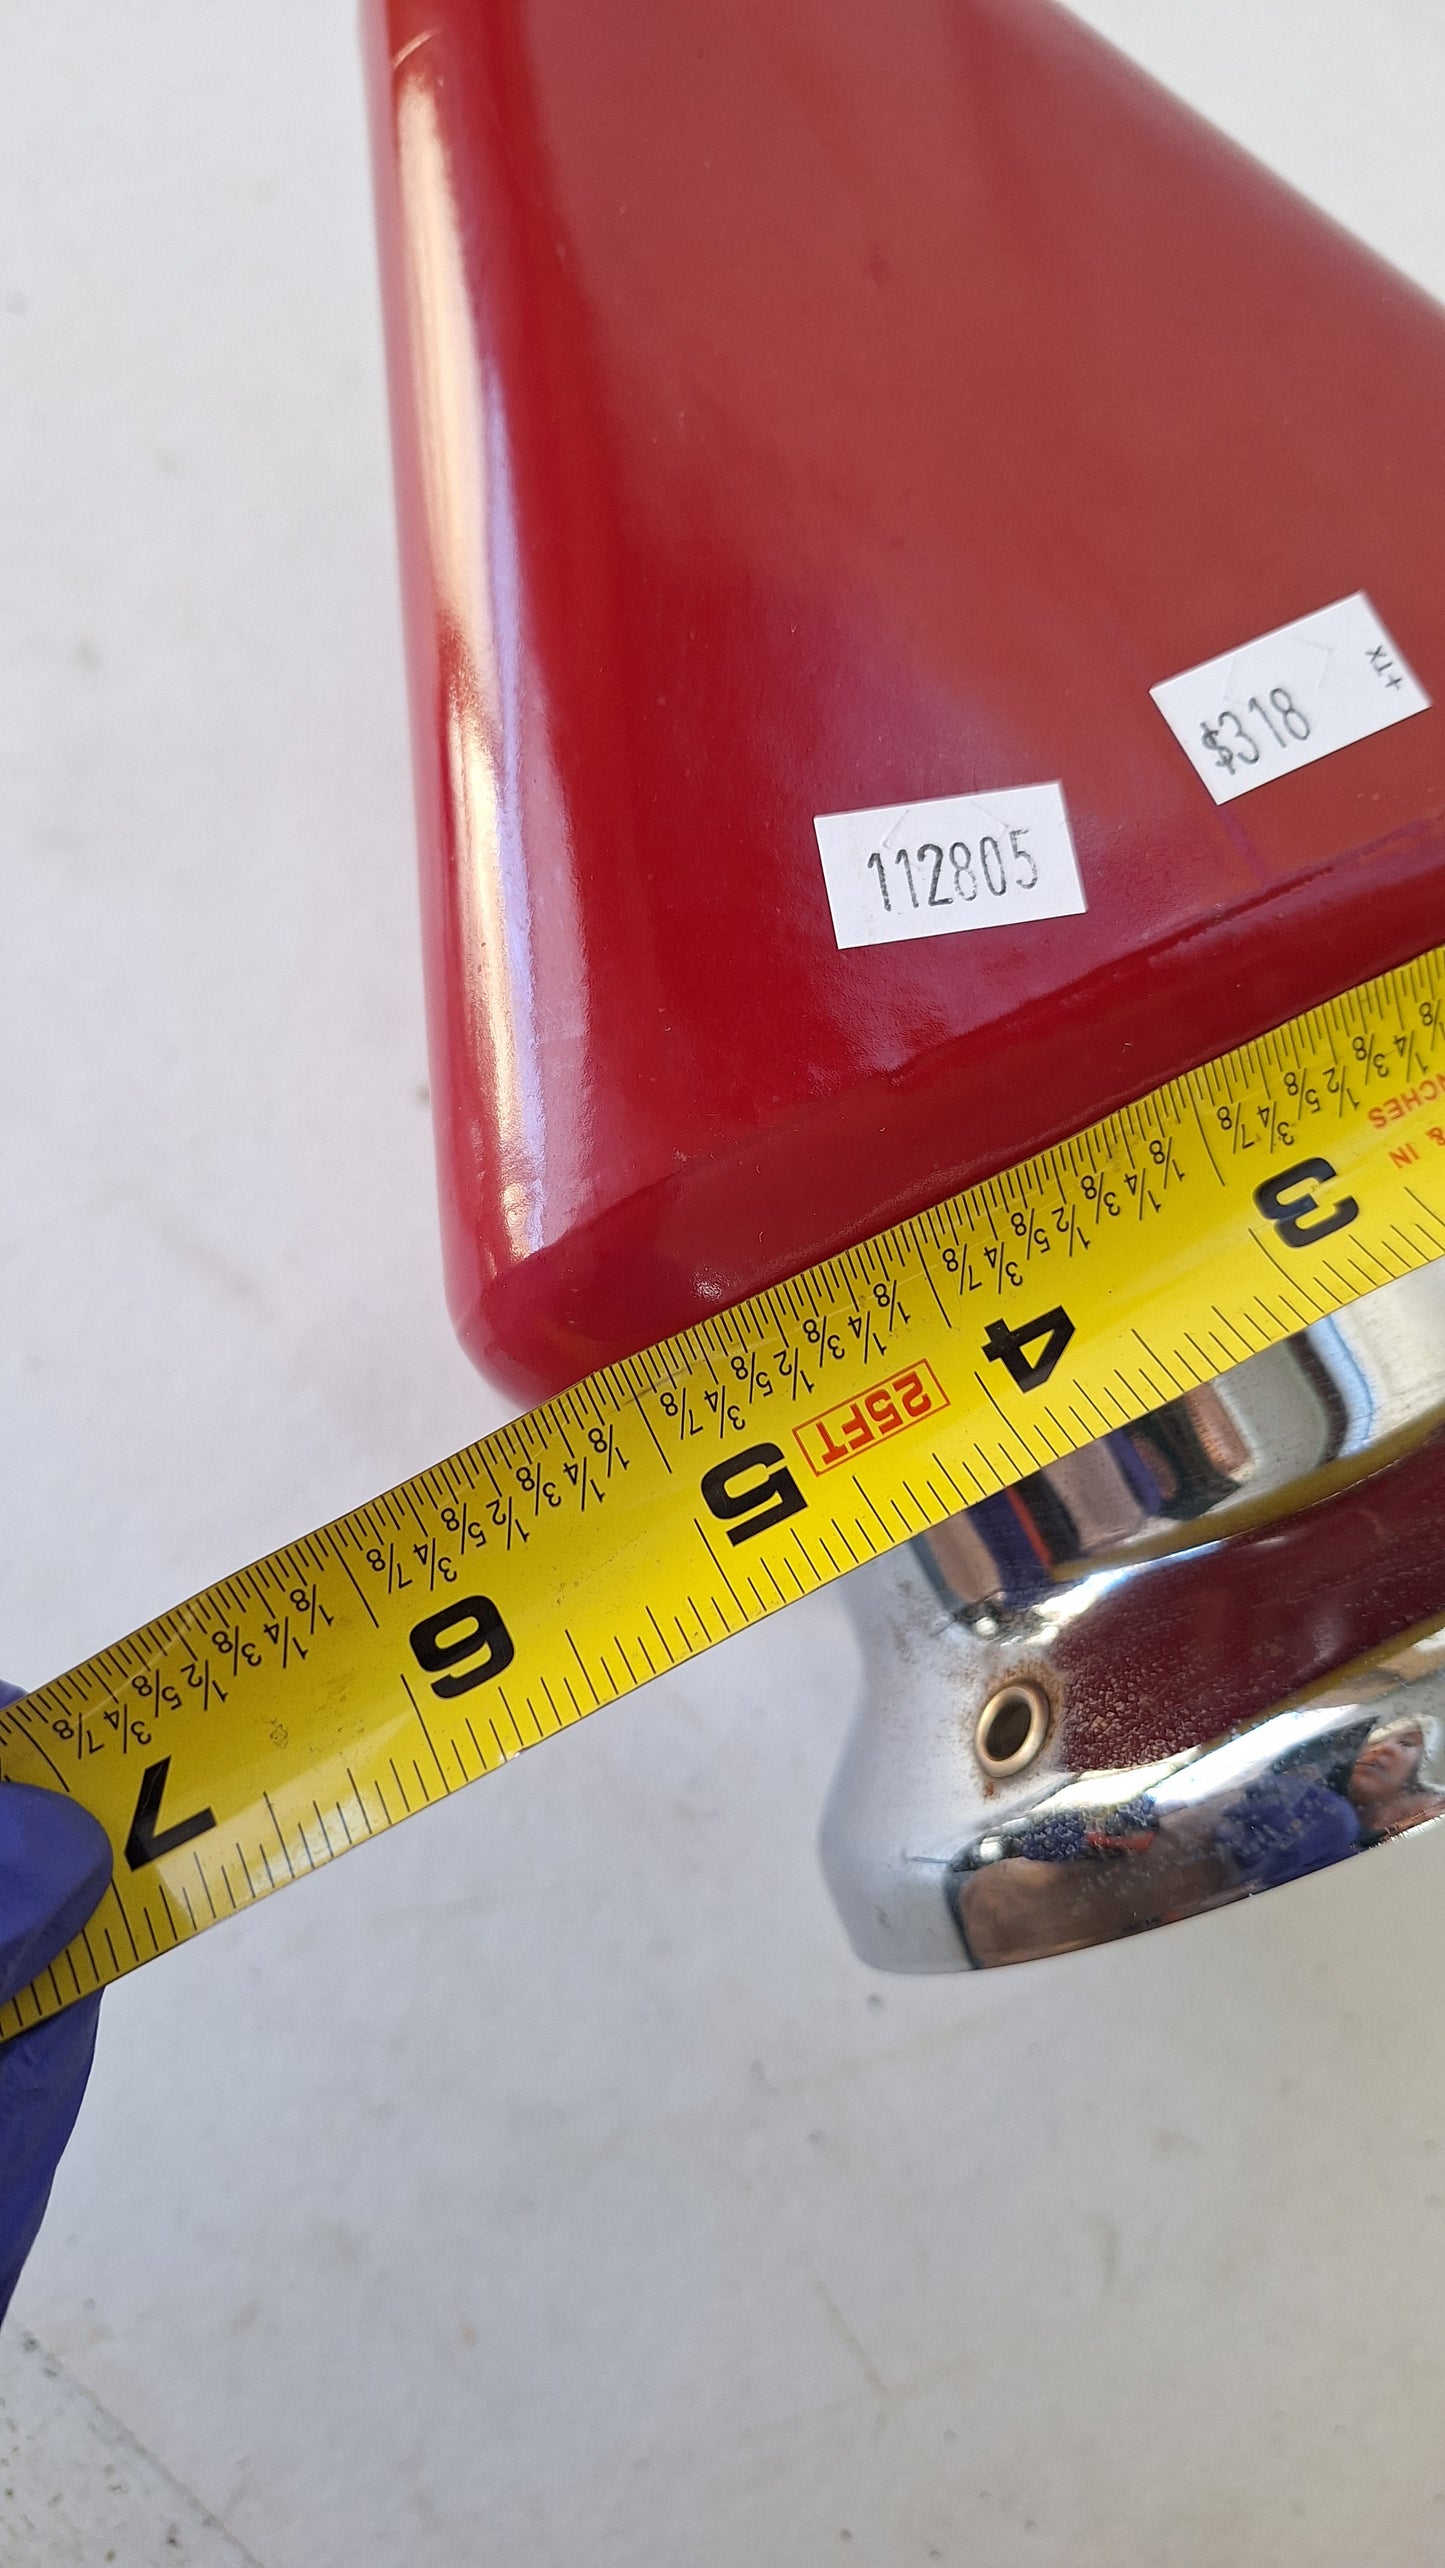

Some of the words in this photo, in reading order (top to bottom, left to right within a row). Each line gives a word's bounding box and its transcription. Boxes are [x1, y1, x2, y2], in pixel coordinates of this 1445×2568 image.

[1200, 687, 1311, 775] $318
[867, 829, 1038, 911] 112805
[1352, 1033, 1389, 1085] 3/8
[1393, 1030, 1428, 1082] 1/4
[1284, 1068, 1321, 1120] 5/8
[1323, 1066, 1360, 1118] 1/2
[1217, 1102, 1255, 1154] 7/8
[1257, 1101, 1294, 1153] 3/4
[1149, 1137, 1185, 1189] 1/8
[1389, 1143, 1419, 1169] IN
[1081, 1171, 1121, 1224] 3/8
[1124, 1168, 1161, 1220] 1/4
[1253, 1157, 1359, 1248] 3
[1011, 1208, 1050, 1260] 5/8
[1052, 1204, 1090, 1257] 1/2
[942, 1243, 982, 1295] 7/8
[983, 1242, 1023, 1294] 3/4
[873, 1280, 911, 1332] 1/8
[803, 1315, 845, 1368] 3/8
[848, 1311, 887, 1363] 1/4
[980, 1305, 1076, 1394] 4
[731, 1351, 773, 1404] 5/8
[773, 1347, 815, 1401] 1/2
[660, 1387, 703, 1440] 7/8
[704, 1385, 745, 1438] 3/4
[816, 1371, 932, 1465] 25FT
[588, 1424, 630, 1478] 1/8
[515, 1462, 562, 1516] 3/8
[563, 1456, 606, 1512] 1/4
[700, 1442, 809, 1547] 5
[440, 1502, 486, 1555] 5/8
[486, 1496, 530, 1550] 1/2
[366, 1543, 413, 1594] 7/8
[413, 1537, 457, 1591] 3/4
[289, 1584, 335, 1635] 1/8
[212, 1625, 262, 1676] 3/8
[263, 1616, 309, 1669] 1/4
[409, 1595, 514, 1699] 6
[132, 1669, 182, 1718] 5/8
[181, 1660, 229, 1711] 1/2
[52, 1712, 105, 1760] 7/8
[104, 1703, 152, 1754] 3/4
[124, 1754, 218, 1872] 7
